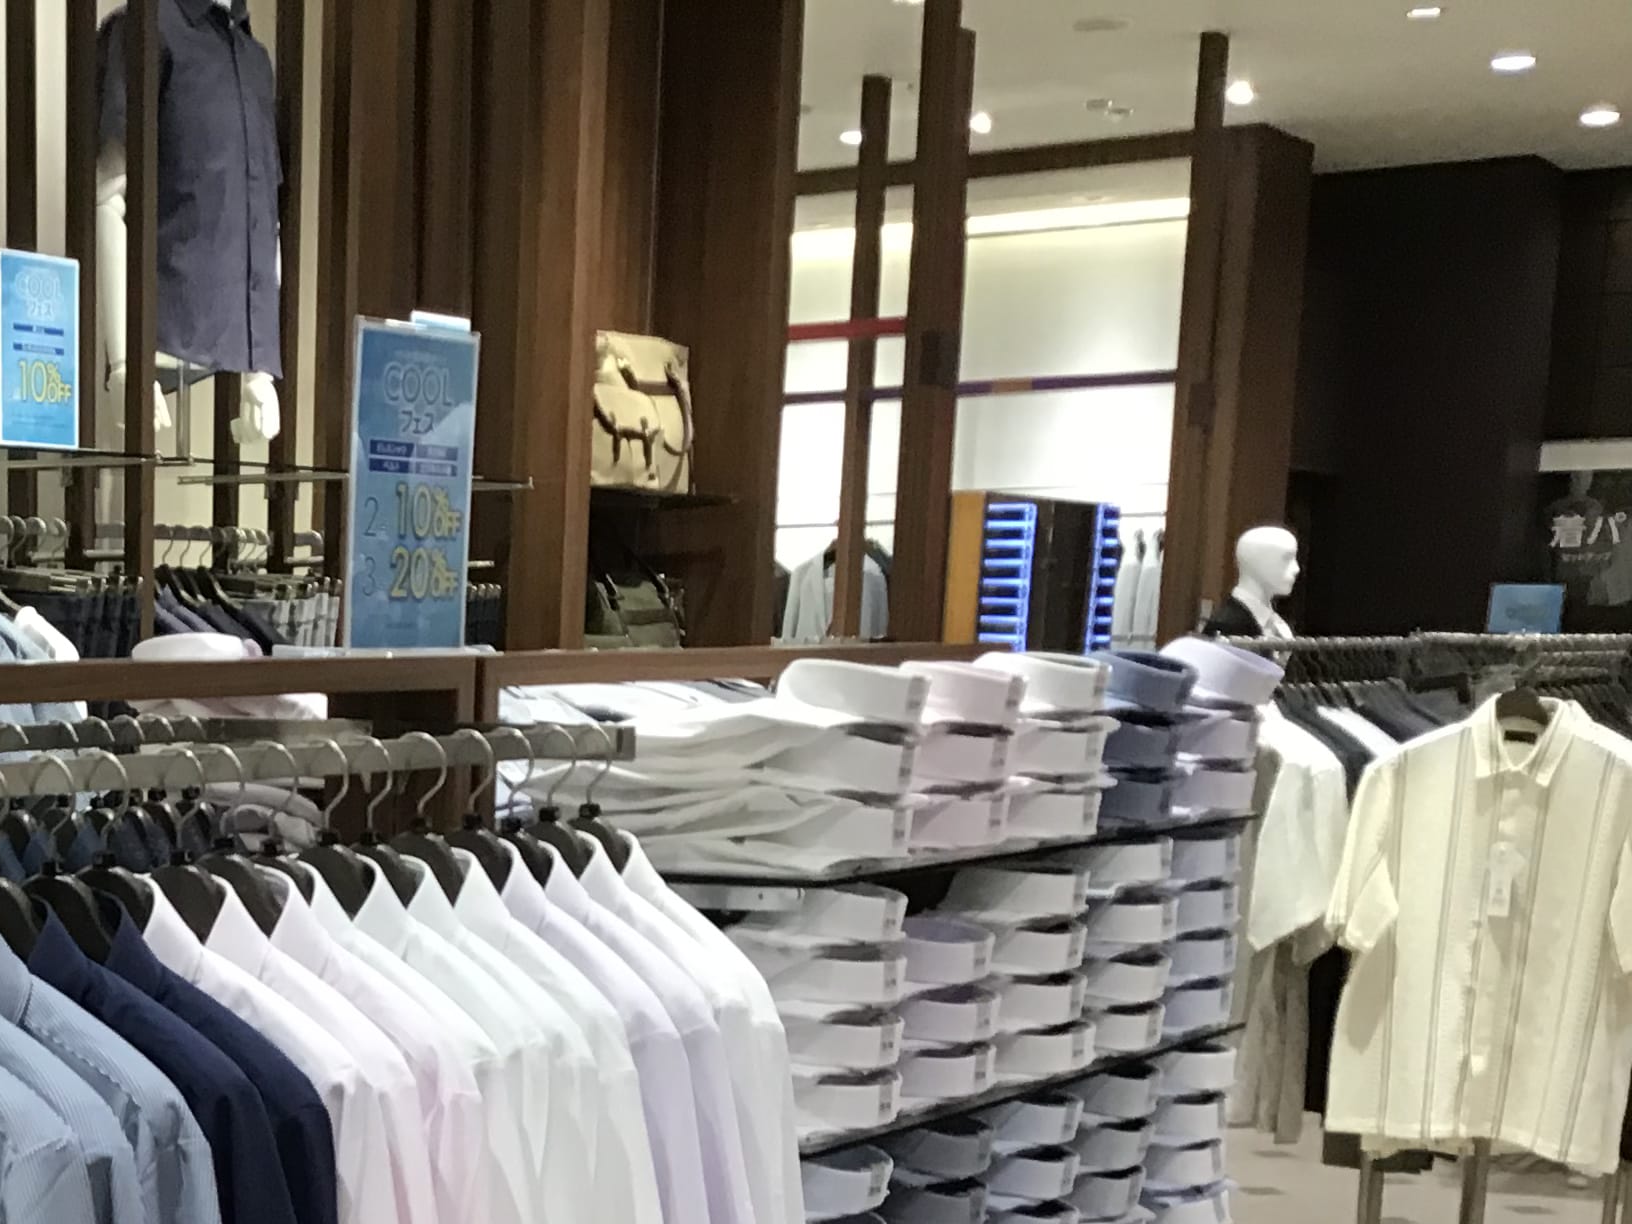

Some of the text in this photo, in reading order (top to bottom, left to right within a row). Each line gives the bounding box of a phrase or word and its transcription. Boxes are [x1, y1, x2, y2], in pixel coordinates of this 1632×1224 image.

[383, 362, 453, 408] COOL
[399, 409, 436, 434] フェス
